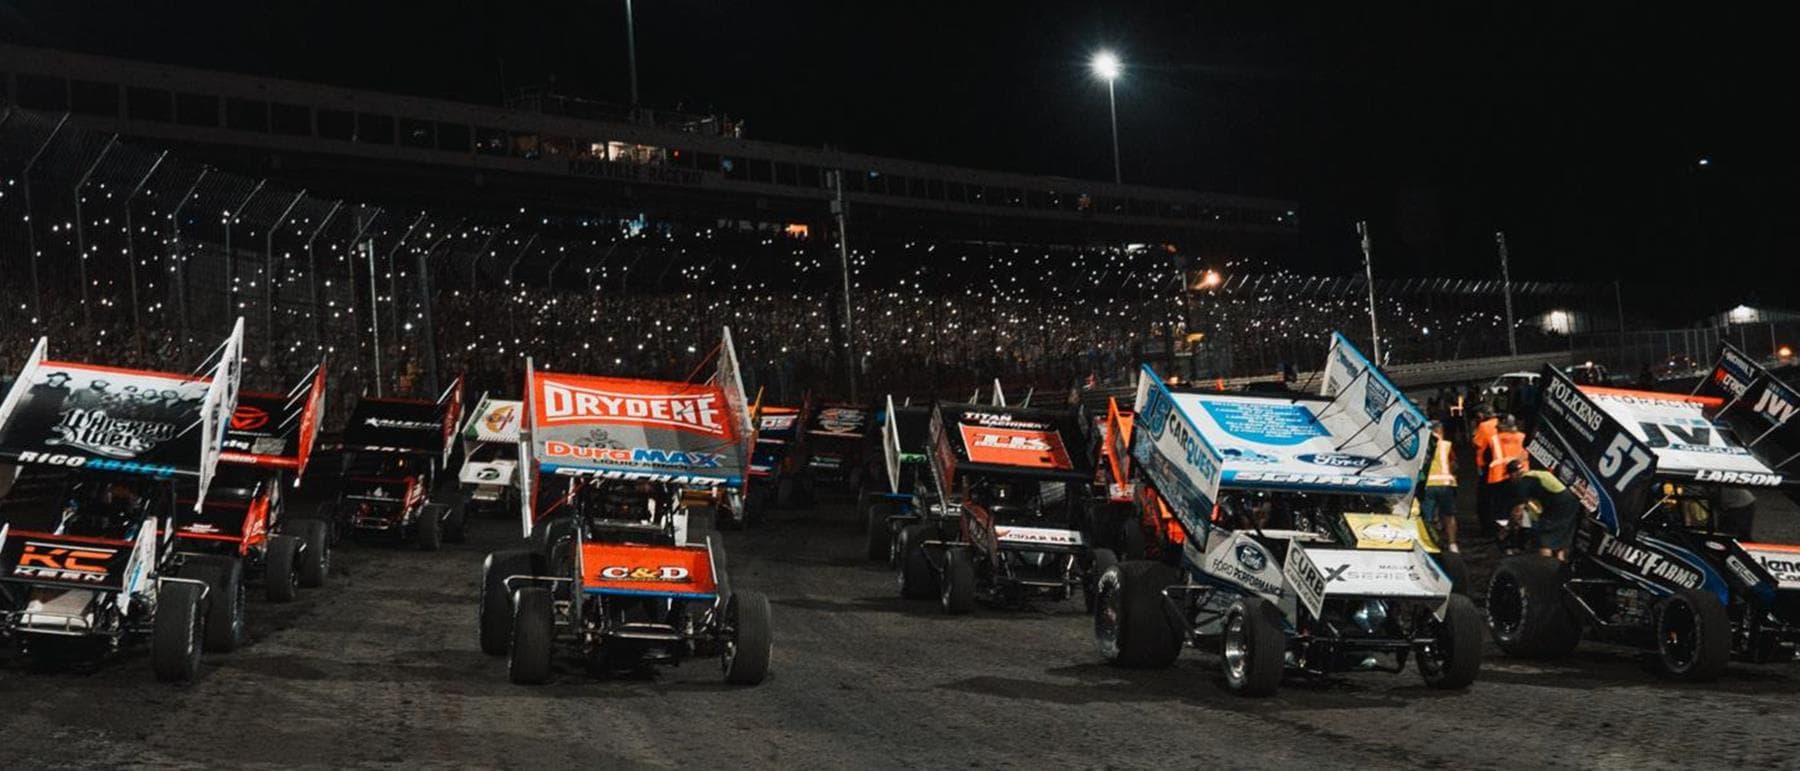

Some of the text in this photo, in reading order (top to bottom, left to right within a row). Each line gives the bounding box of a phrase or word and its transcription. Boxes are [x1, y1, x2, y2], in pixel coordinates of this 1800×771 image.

[543, 383, 722, 430] DRYDENE
[962, 412, 1012, 422] TITAN
[17, 452, 87, 467] RICO
[545, 441, 726, 468] DuraMAX
[1168, 413, 1218, 486] CARQUEST
[1314, 453, 1368, 467] Ford
[1598, 431, 1653, 492] 57
[1233, 471, 1393, 487] SCHATZ
[1694, 469, 1783, 487] LARSON
[601, 566, 689, 580] C&D
[1290, 547, 1325, 597] CURB
[1597, 532, 1648, 567] FINLEY
[1640, 550, 1699, 589] FARMS
[1211, 558, 1234, 577] FORD
[1232, 567, 1281, 595] PERFORMANC
